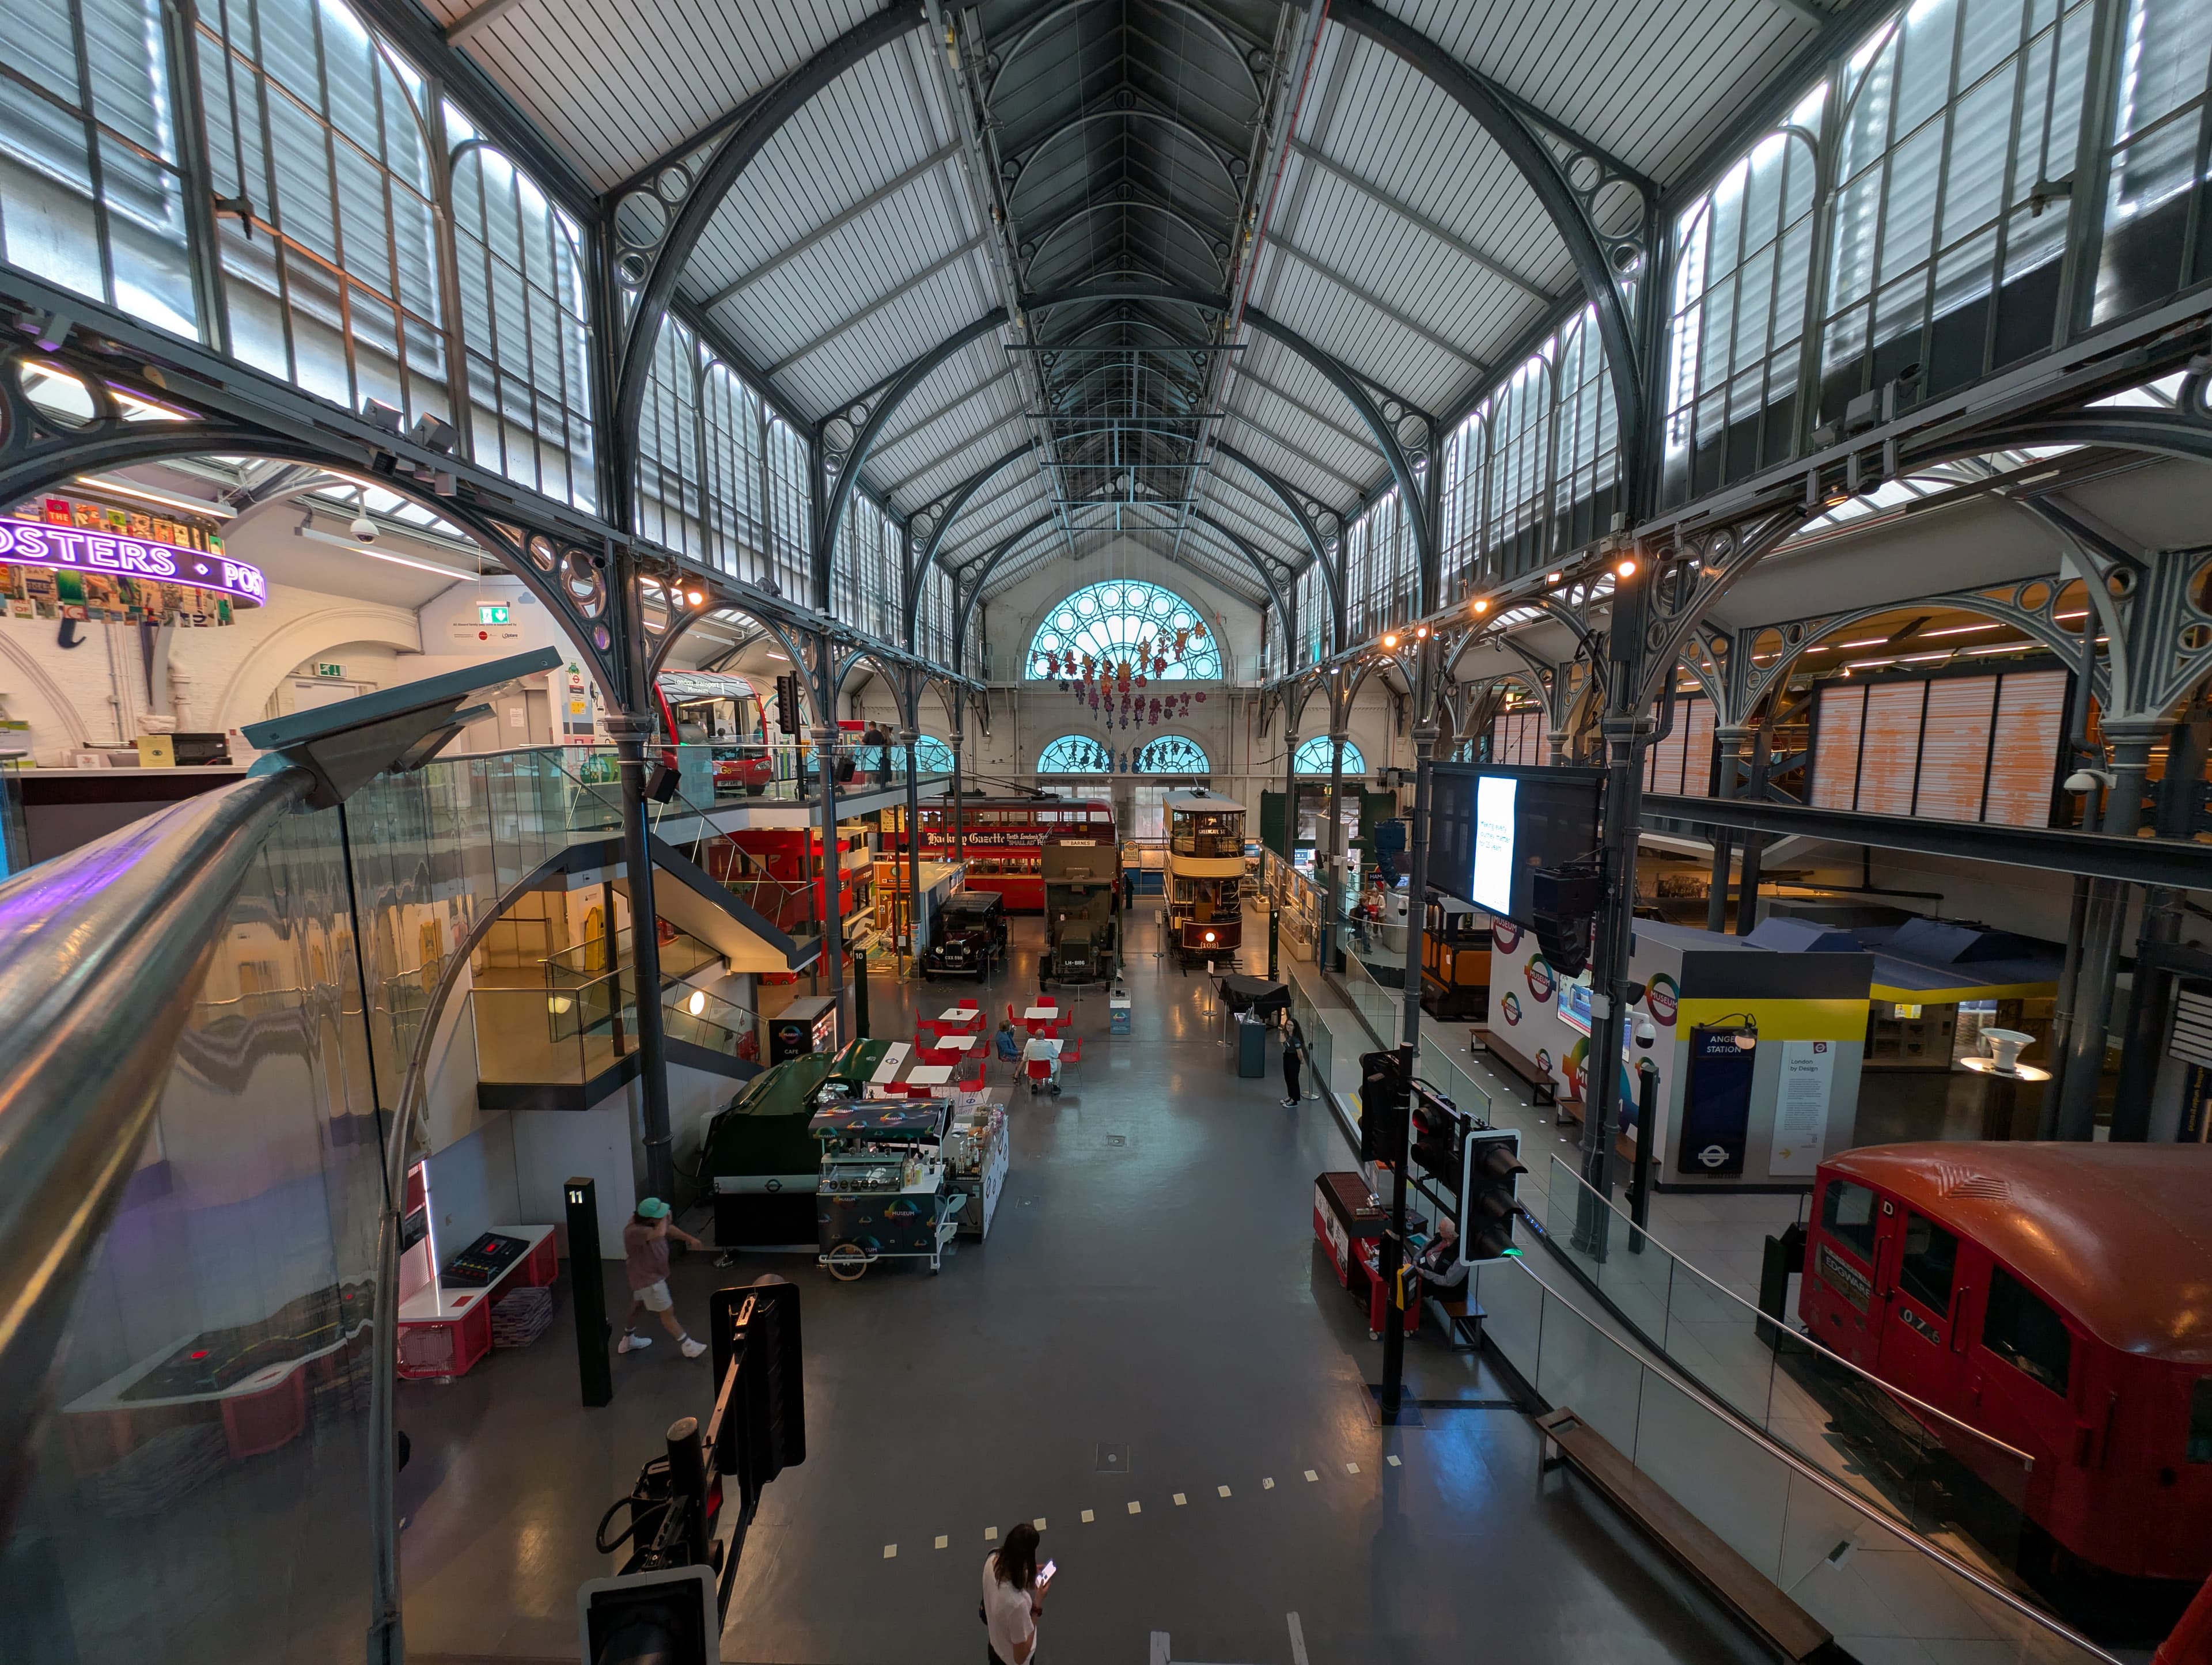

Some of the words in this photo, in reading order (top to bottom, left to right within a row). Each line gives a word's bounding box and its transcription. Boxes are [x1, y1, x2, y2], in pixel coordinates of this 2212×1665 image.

[50, 512, 69, 521] THE
[694, 680, 720, 688] Transport
[720, 766, 732, 774] Go
[969, 833, 1005, 844] Gazette
[1494, 915, 1517, 932] MUSEUM
[1529, 970, 1551, 987] MUSEUM
[1650, 990, 1678, 1007] MUSEUM
[569, 1190, 582, 1204] 11
[1884, 1201, 1893, 1215] D
[1825, 1256, 1871, 1296] EDGWARE
